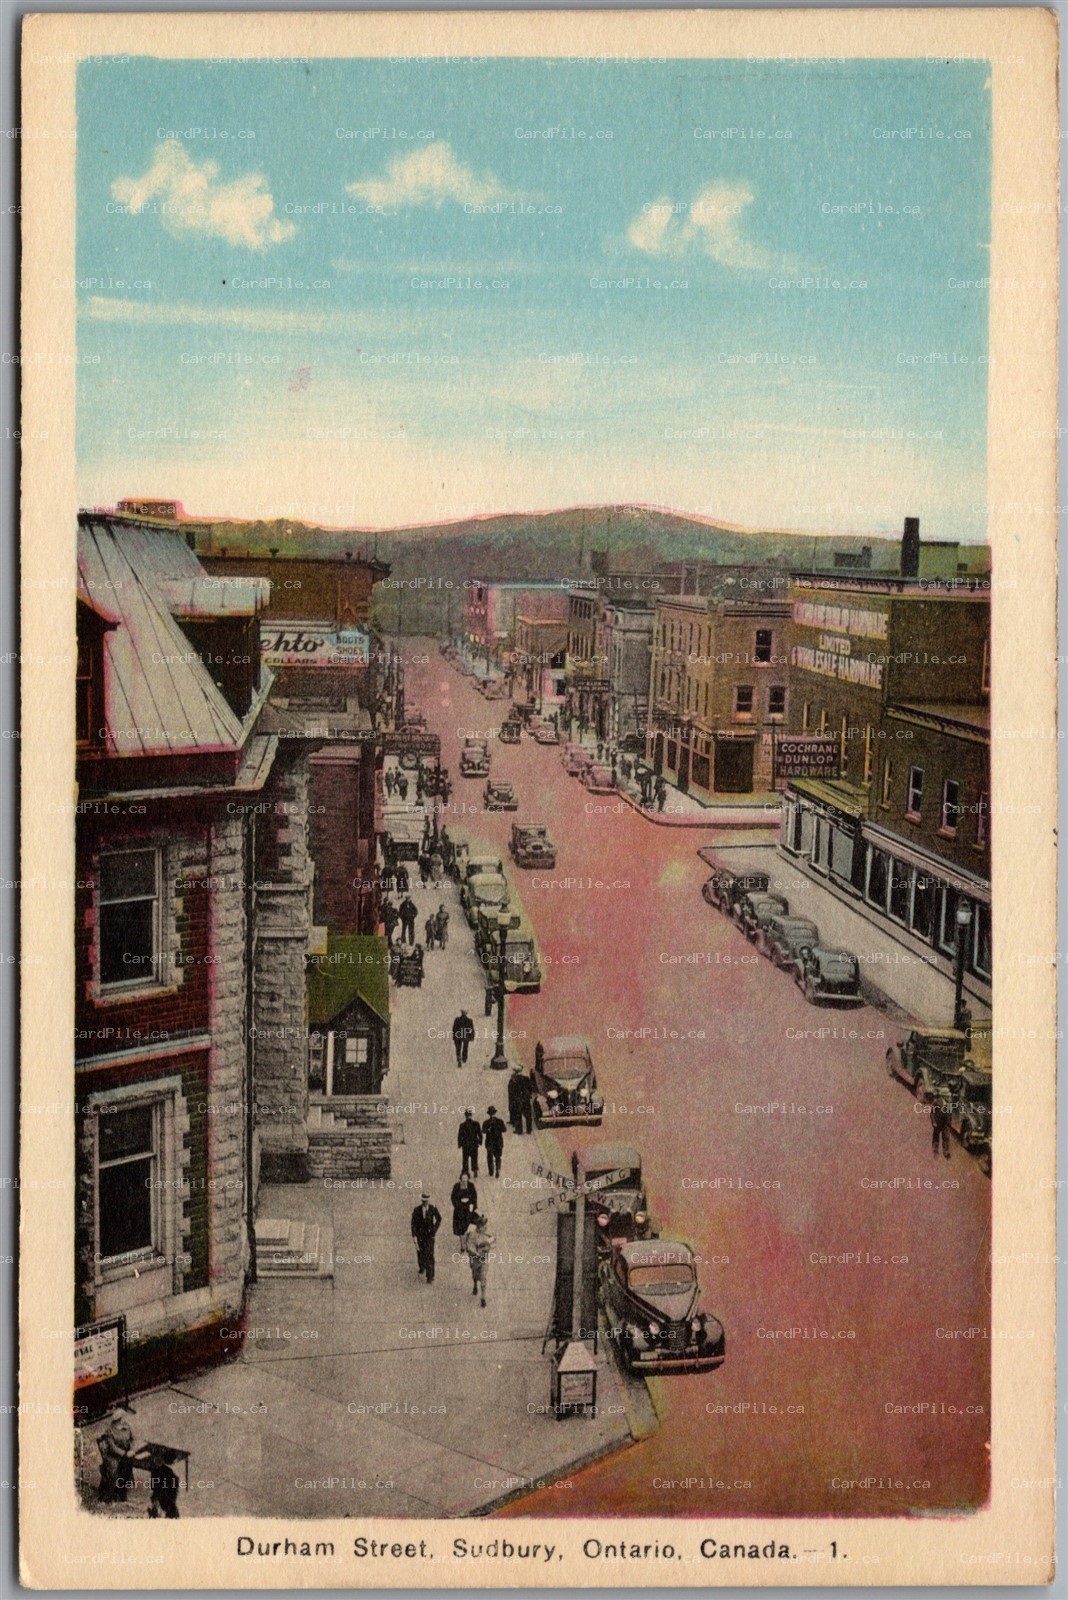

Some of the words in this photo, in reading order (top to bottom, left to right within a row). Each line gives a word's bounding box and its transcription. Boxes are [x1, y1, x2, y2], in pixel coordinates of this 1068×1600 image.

[819, 633, 851, 655] LIMITED
[336, 646, 364, 655] SHOES
[264, 657, 318, 665] COLLARS
[781, 743, 839, 754] COCHRANE
[784, 754, 834, 764] DUNLOP
[780, 765, 838, 777] HARDWARE
